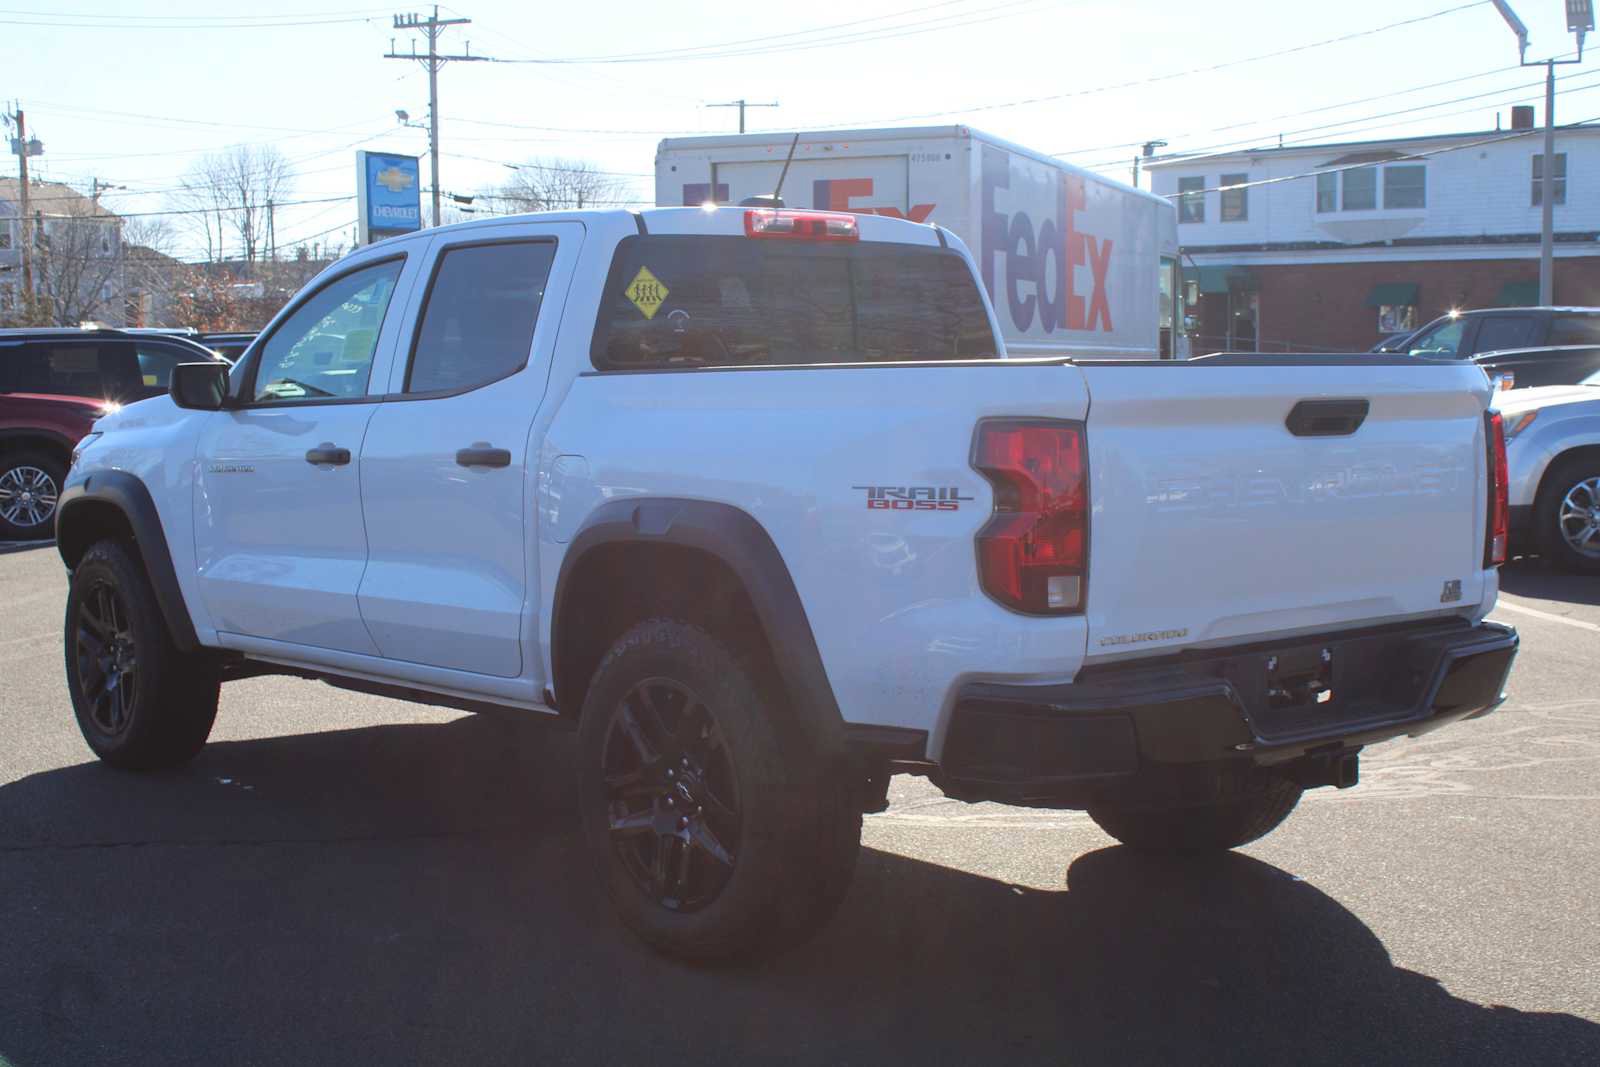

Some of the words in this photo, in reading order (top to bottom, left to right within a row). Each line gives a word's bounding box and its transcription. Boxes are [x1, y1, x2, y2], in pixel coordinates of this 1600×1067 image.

[982, 144, 1113, 334] FedEx
[851, 486, 974, 500] TRAIL
[867, 499, 959, 511] BOSS
